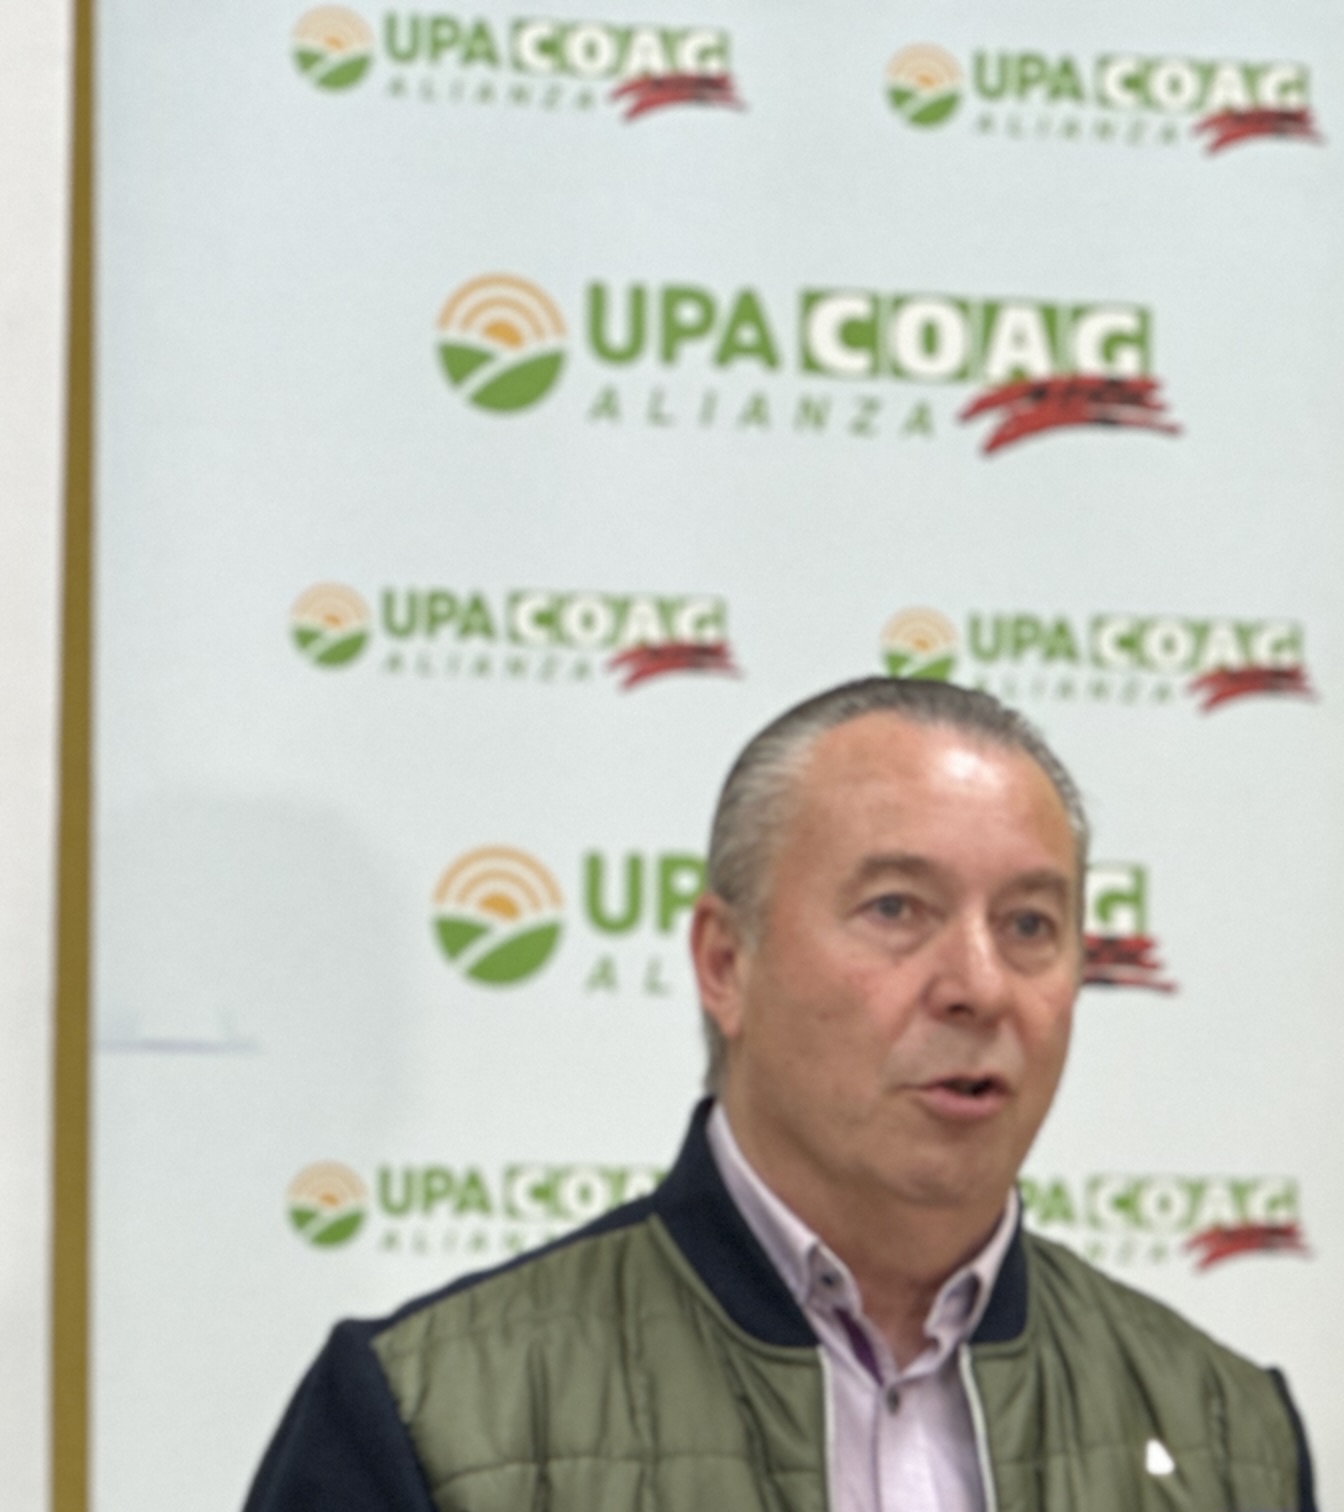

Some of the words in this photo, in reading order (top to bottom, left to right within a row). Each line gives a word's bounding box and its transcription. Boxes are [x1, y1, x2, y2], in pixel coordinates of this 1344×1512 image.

[383, 11, 500, 67] UPA
[517, 21, 726, 78] COAG
[973, 51, 1083, 105] UPA
[1102, 58, 1303, 112] COAG
[586, 278, 780, 369] UPA
[806, 290, 1146, 380] COAG
[588, 386, 937, 440] ALIANZA
[379, 587, 495, 640] UPA
[514, 595, 724, 647] COAG
[967, 612, 1079, 665] UPA
[1097, 619, 1301, 672] COAG
[585, 853, 708, 934] UP
[377, 1162, 494, 1216] UPA
[1094, 1178, 1298, 1231] COAG
